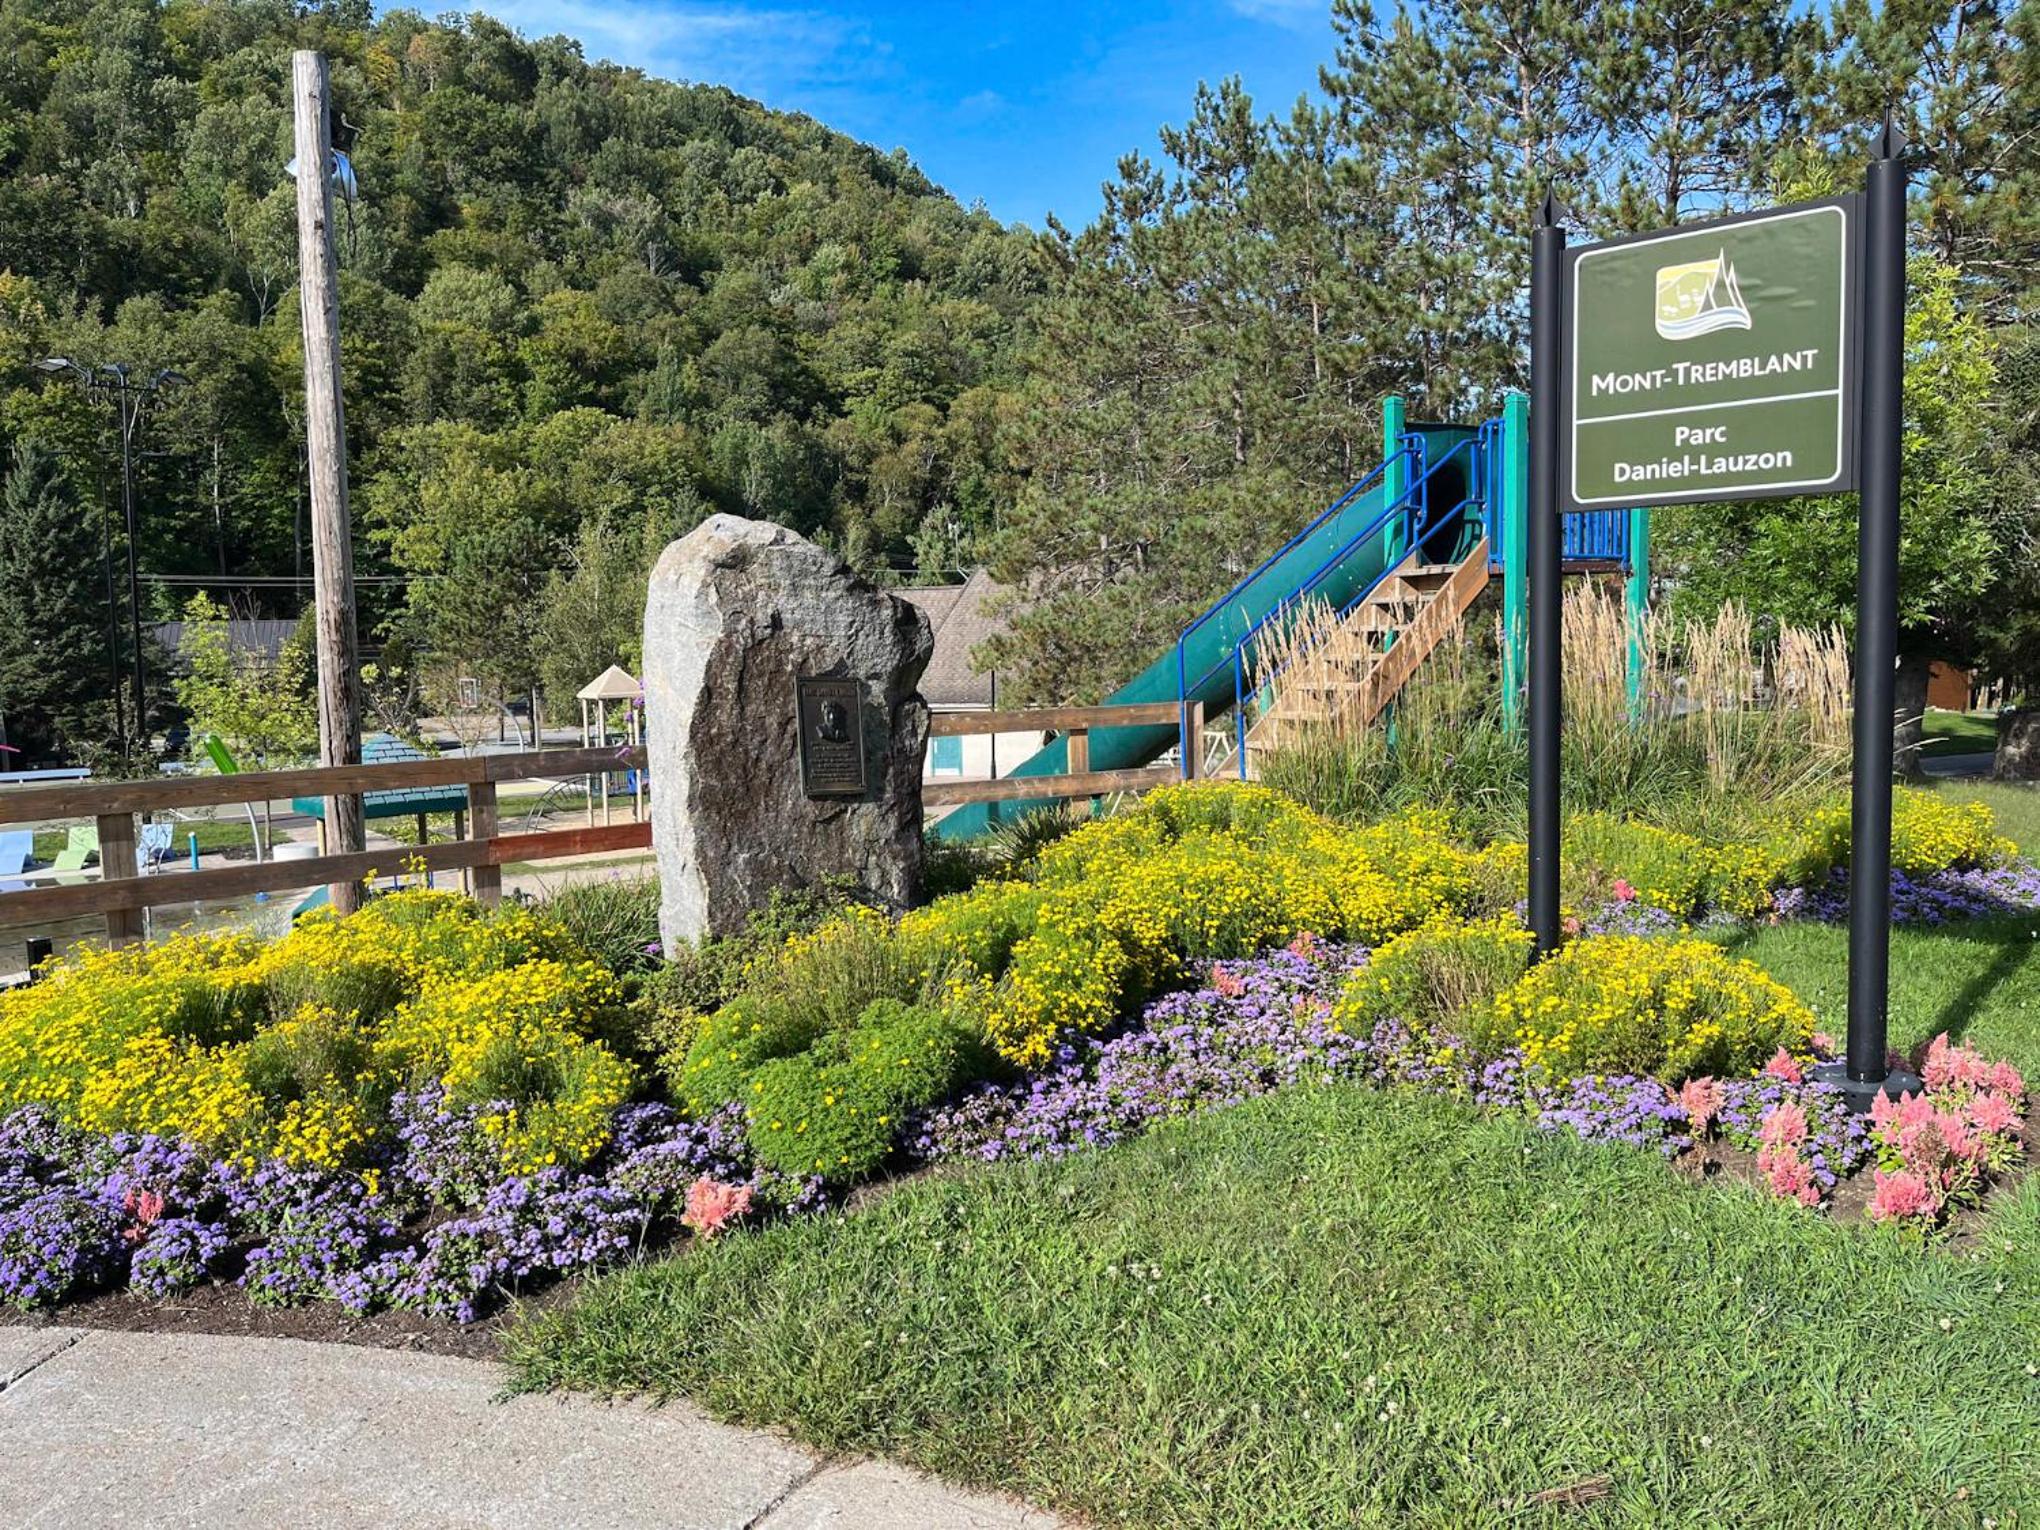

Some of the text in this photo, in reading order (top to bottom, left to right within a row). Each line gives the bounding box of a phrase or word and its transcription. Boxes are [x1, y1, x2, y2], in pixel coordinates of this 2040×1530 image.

[1591, 349, 1818, 396] MONT-TREMBLANT
[1675, 426, 1727, 447] Parc
[1613, 450, 1792, 482] Daniel-Lauzon
